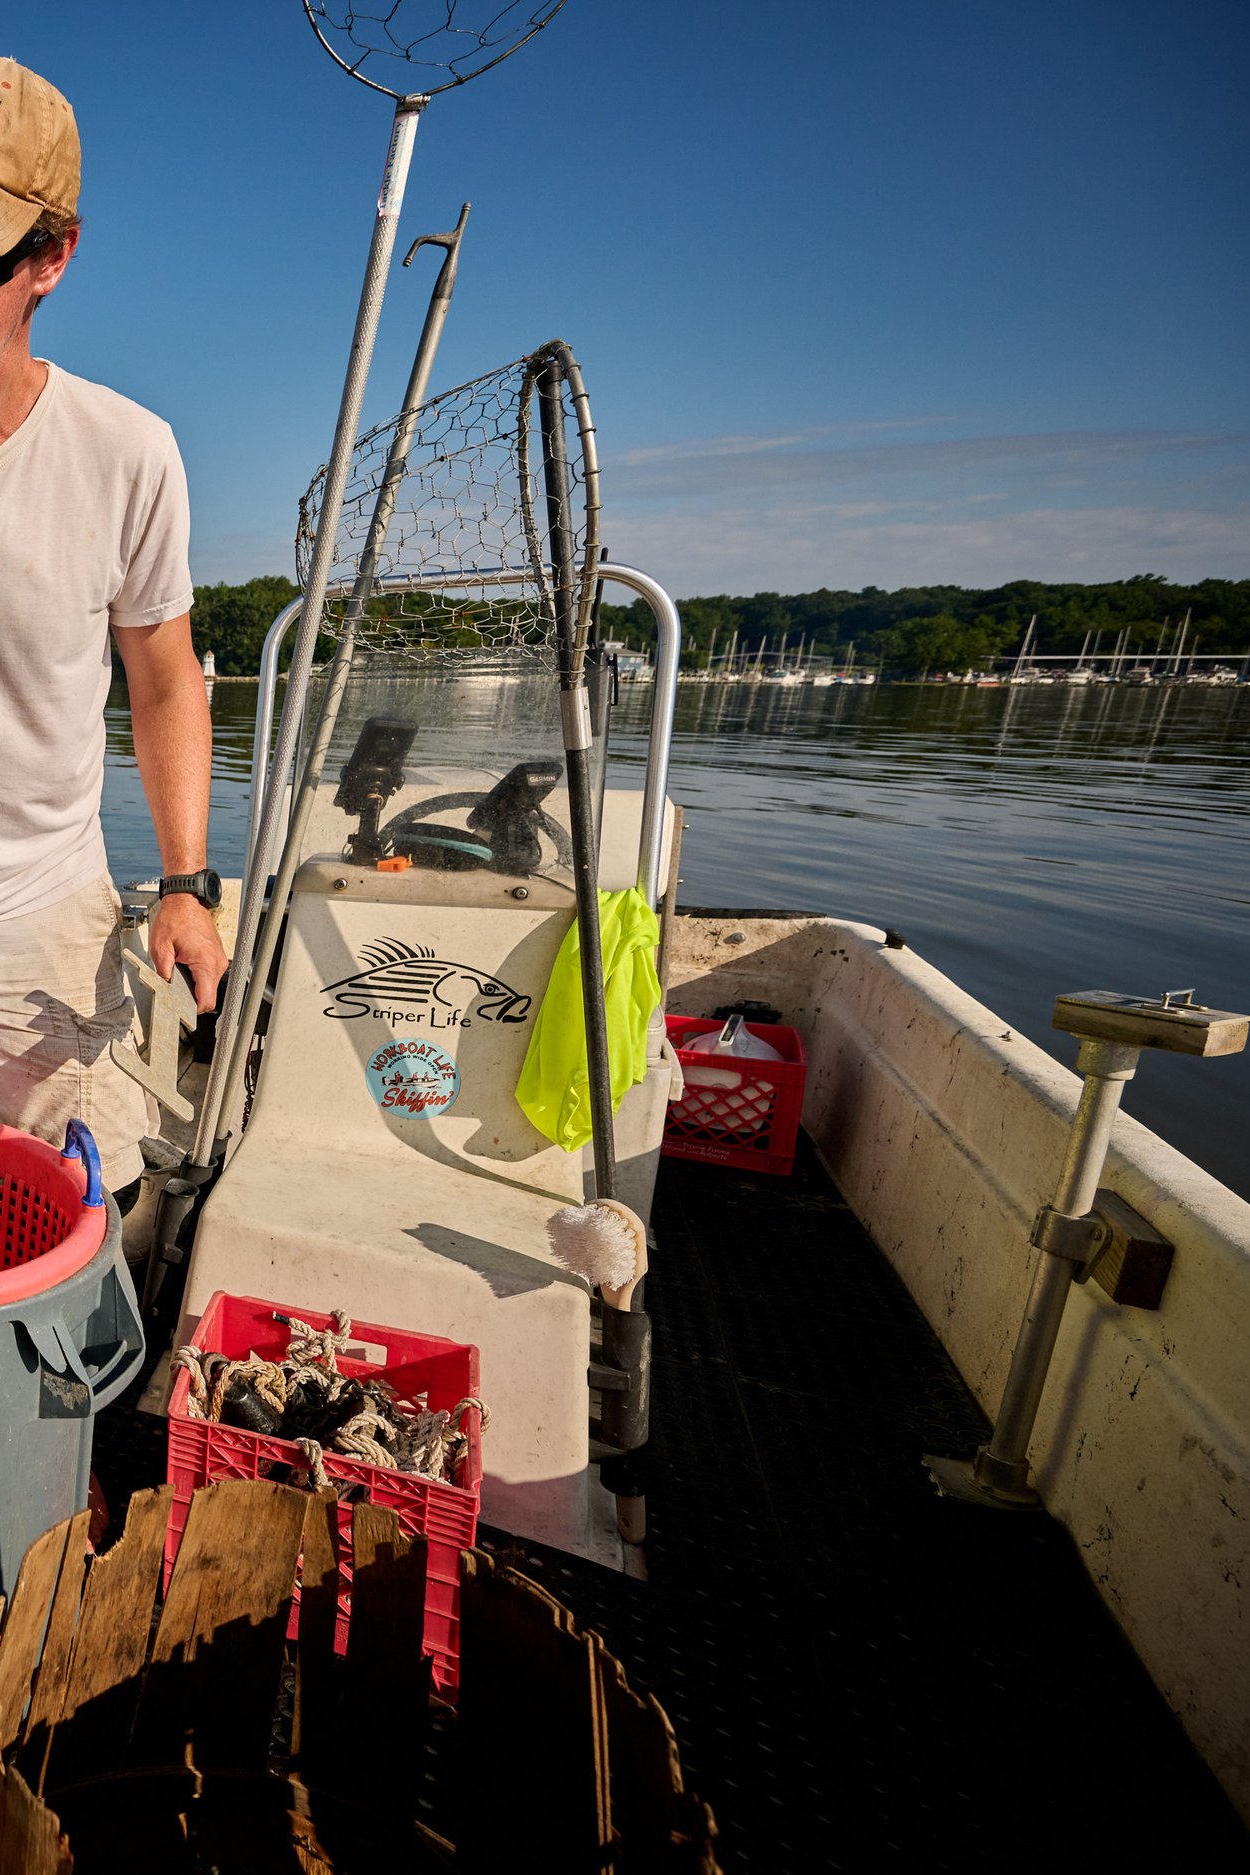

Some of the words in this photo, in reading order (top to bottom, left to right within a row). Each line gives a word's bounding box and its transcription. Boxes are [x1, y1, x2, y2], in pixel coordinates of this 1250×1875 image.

[529, 775, 556, 783] GARMIN
[323, 993, 427, 1028] Striper
[430, 1007, 472, 1029] Life
[370, 1042, 438, 1072] WORKBOAT
[433, 1054, 457, 1080] LIFE
[388, 1055, 411, 1069] WORKING
[412, 1054, 427, 1062] WIDE
[428, 1061, 442, 1075] OPEN
